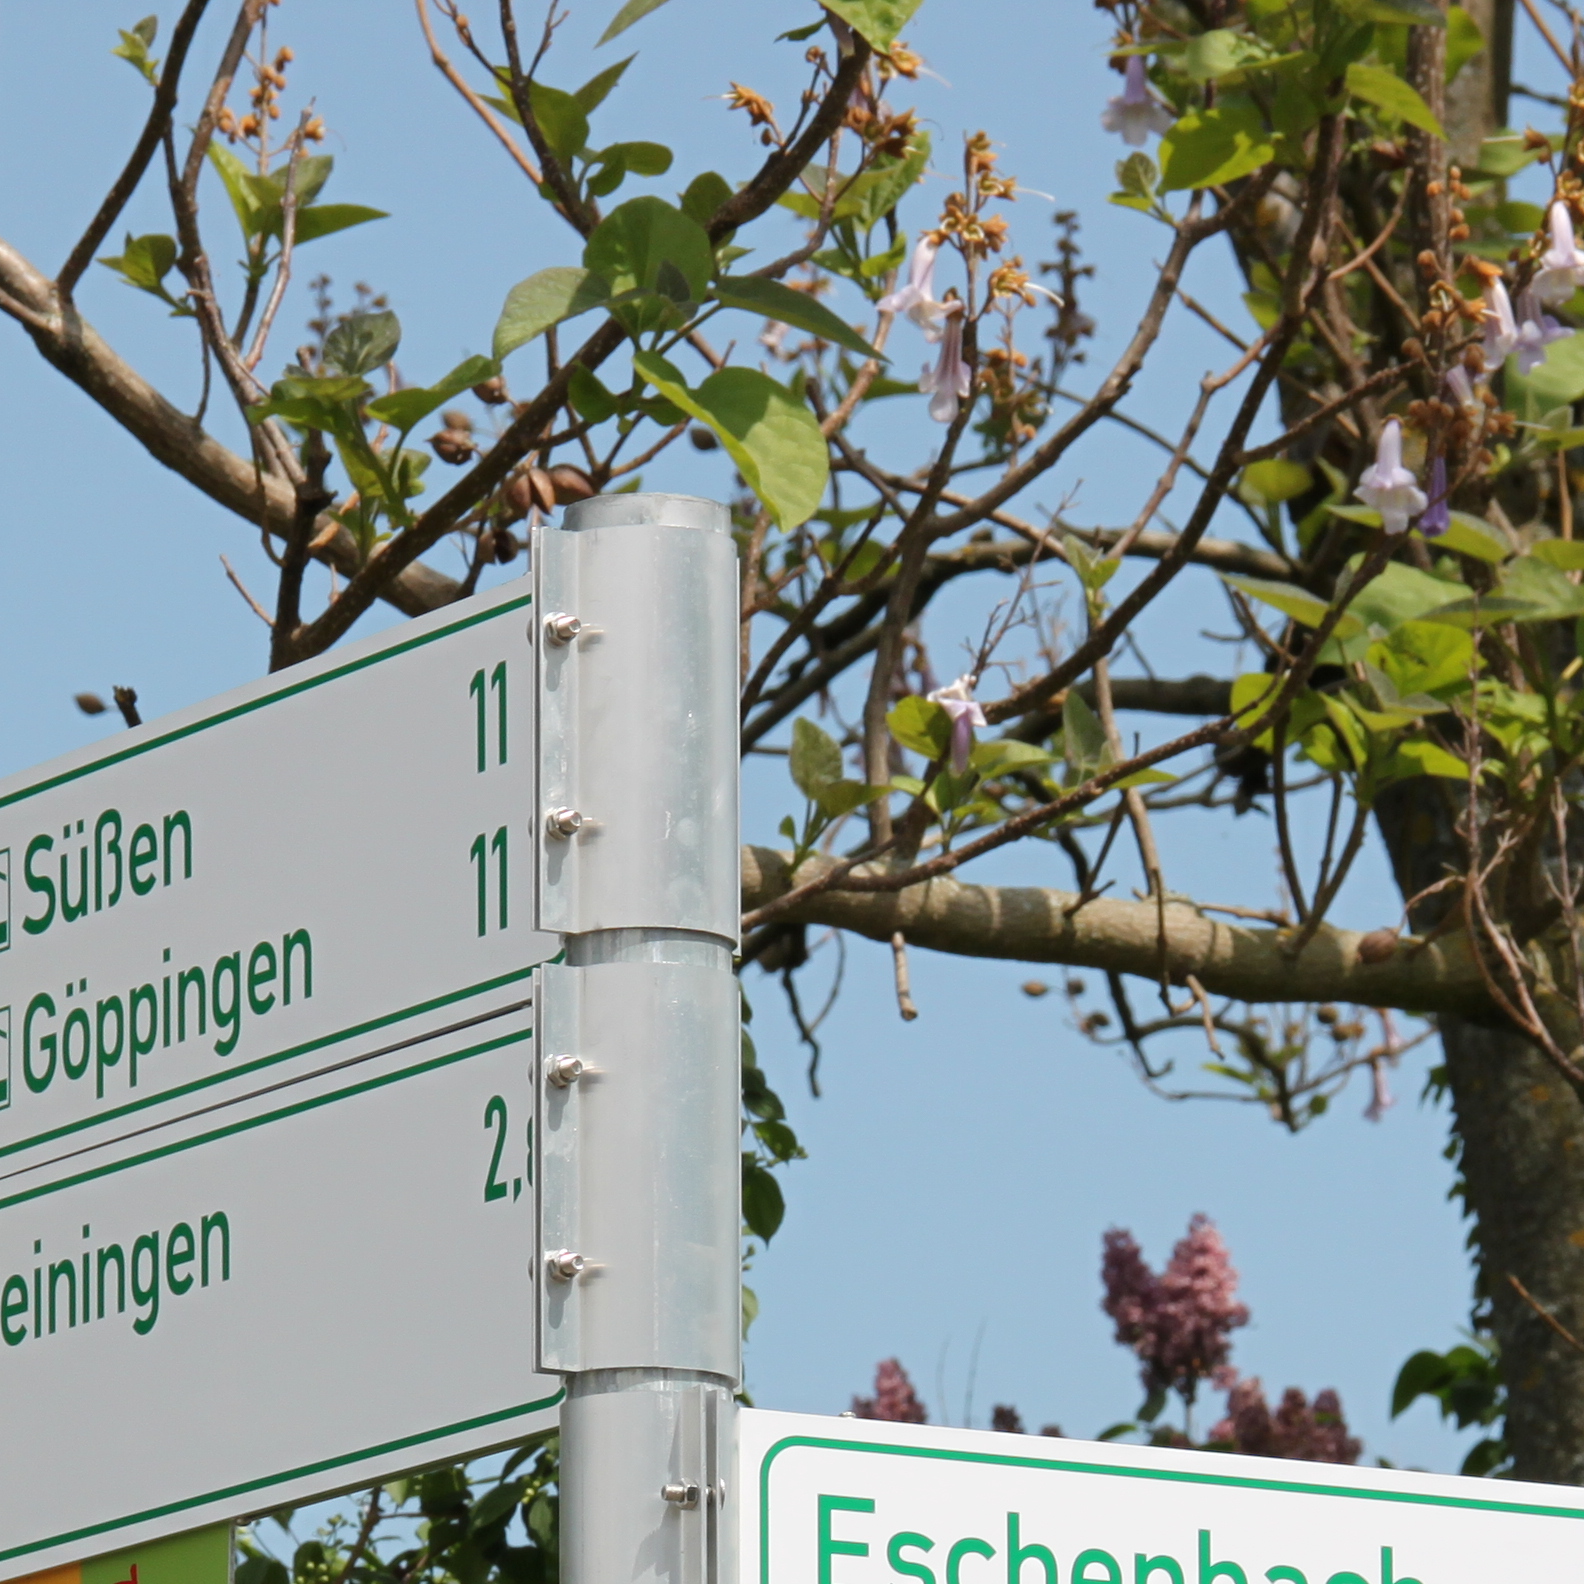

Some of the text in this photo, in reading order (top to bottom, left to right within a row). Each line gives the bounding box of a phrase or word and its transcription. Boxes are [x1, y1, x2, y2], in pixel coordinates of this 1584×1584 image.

[469, 660, 508, 773] 11
[22, 808, 193, 936] Süßen
[469, 825, 508, 937] 11
[22, 927, 314, 1100] Göppingen
